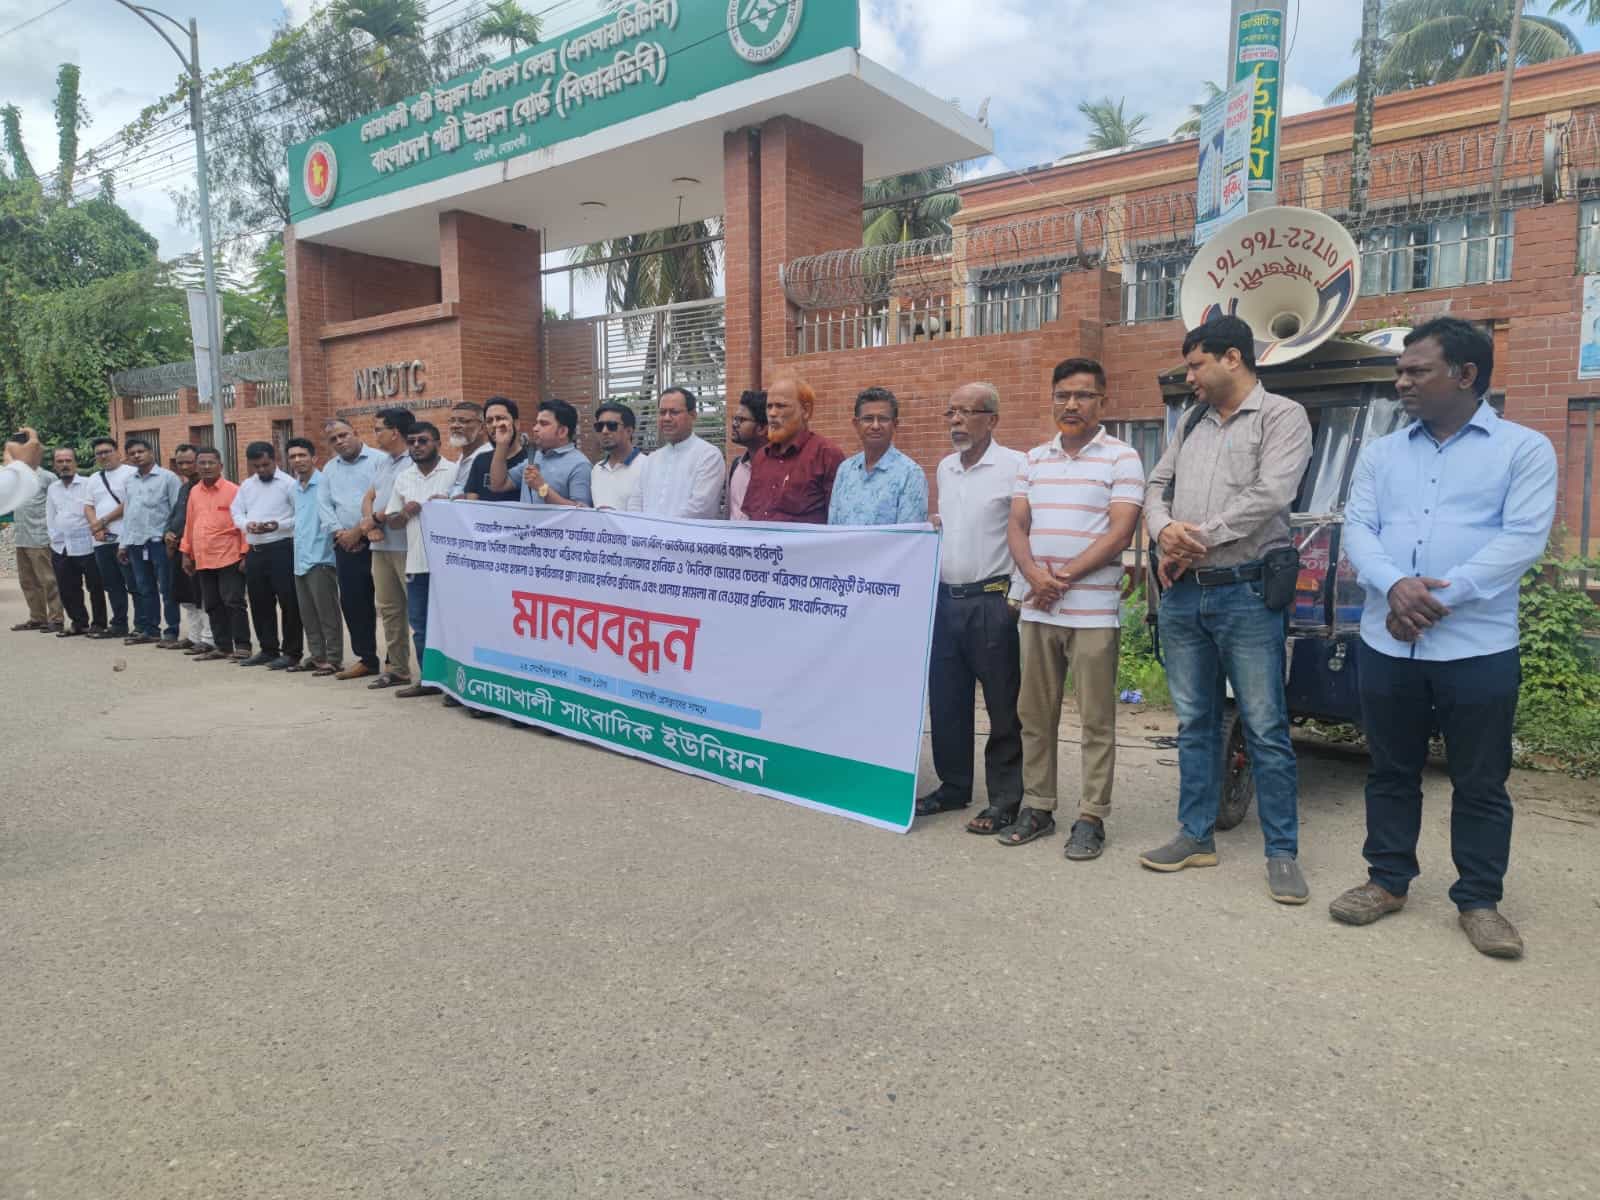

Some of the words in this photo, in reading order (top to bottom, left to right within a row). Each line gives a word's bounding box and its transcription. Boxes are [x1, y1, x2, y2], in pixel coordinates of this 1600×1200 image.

[370, 131, 431, 173] বাংলাদেশ
[432, 115, 461, 151] পল্লী
[463, 106, 509, 143] উন্নয়ন
[512, 79, 552, 126] বোর্ড
[556, 42, 667, 118] (বিআরডিবি)
[1241, 227, 1339, 268] 01722-766
[1208, 249, 1243, 289] 767
[754, 543, 784, 566] হরিলুট
[651, 556, 677, 574] হানিফ
[677, 563, 683, 574] ও
[713, 566, 741, 582] ভোরের
[772, 568, 807, 588] পত্রিকার
[809, 574, 856, 598] সোনাইমুড়ী
[856, 577, 901, 598] উপজেলা
[642, 581, 658, 595] এবং
[659, 583, 681, 598] থানায়
[682, 585, 707, 601] মামলা
[708, 588, 718, 601] না
[718, 590, 749, 607] নেওয়ার
[750, 590, 785, 610] প্রতিবাদে
[788, 597, 848, 619] সাংবাদিকদের
[512, 590, 701, 674] মানববন্ধন
[468, 678, 554, 716] নোয়াখালী
[561, 700, 654, 744] সাংবাদিক
[661, 722, 768, 780] ইউনিয়ন
